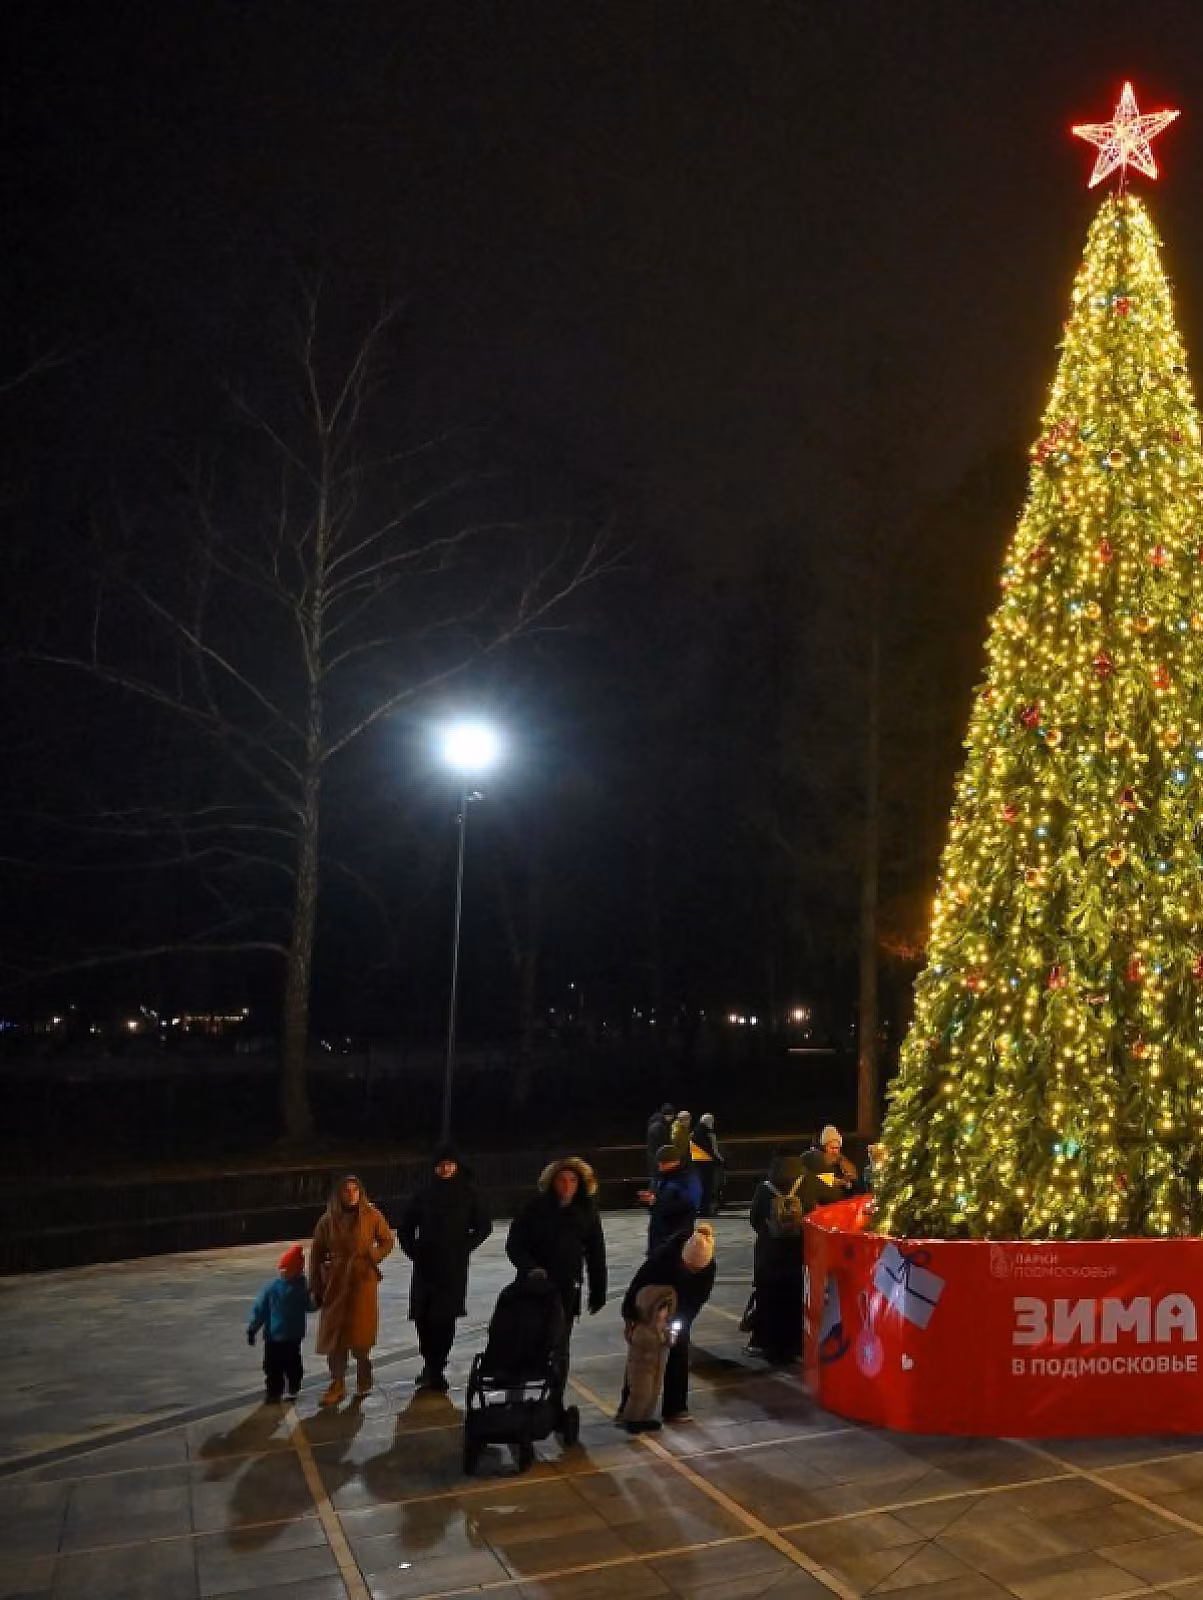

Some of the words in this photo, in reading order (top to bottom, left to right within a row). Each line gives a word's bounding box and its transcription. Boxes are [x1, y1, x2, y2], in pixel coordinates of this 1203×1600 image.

[1016, 1253, 1058, 1264] ПАРКИ
[1014, 1266, 1117, 1278] ПОДМОСКОВЬЯ
[1012, 1293, 1198, 1346] ЗИМА
[1012, 1358, 1026, 1376] В
[1032, 1354, 1198, 1378] ПОДМОСКОВЬЕ
